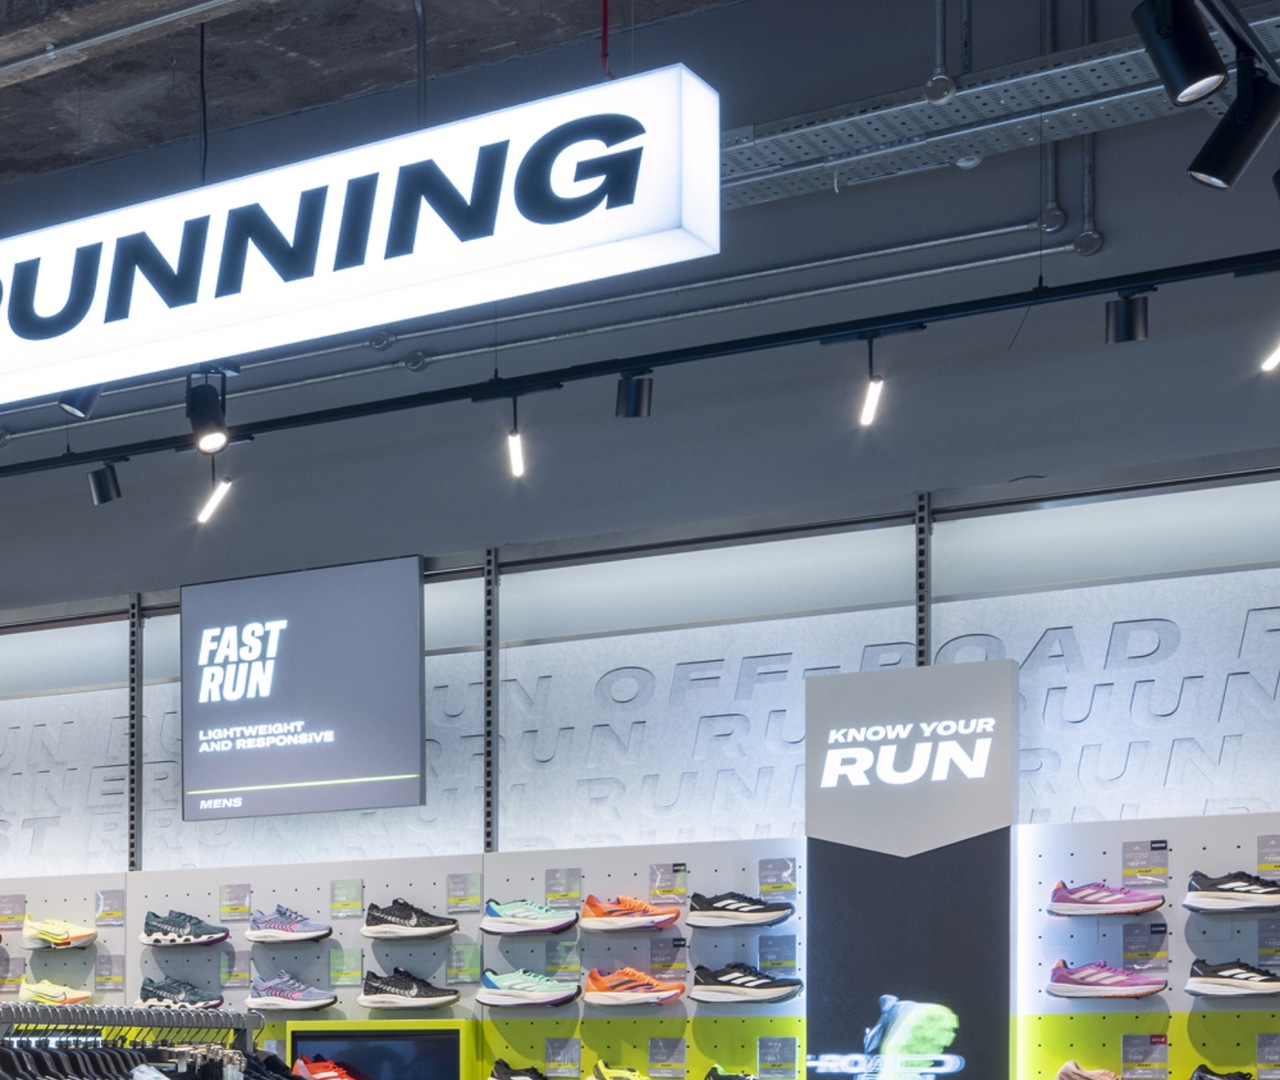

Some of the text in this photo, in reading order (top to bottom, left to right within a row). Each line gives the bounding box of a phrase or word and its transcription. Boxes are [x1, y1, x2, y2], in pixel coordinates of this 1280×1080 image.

[197, 619, 288, 666] FAST
[197, 659, 276, 704] RUN
[198, 720, 305, 742] LIGHTWEIGHT
[198, 730, 335, 753] AND RESPONSIVE
[827, 717, 996, 745] KNOW YOUR
[819, 737, 994, 789] RUN
[198, 796, 244, 811] MENS
